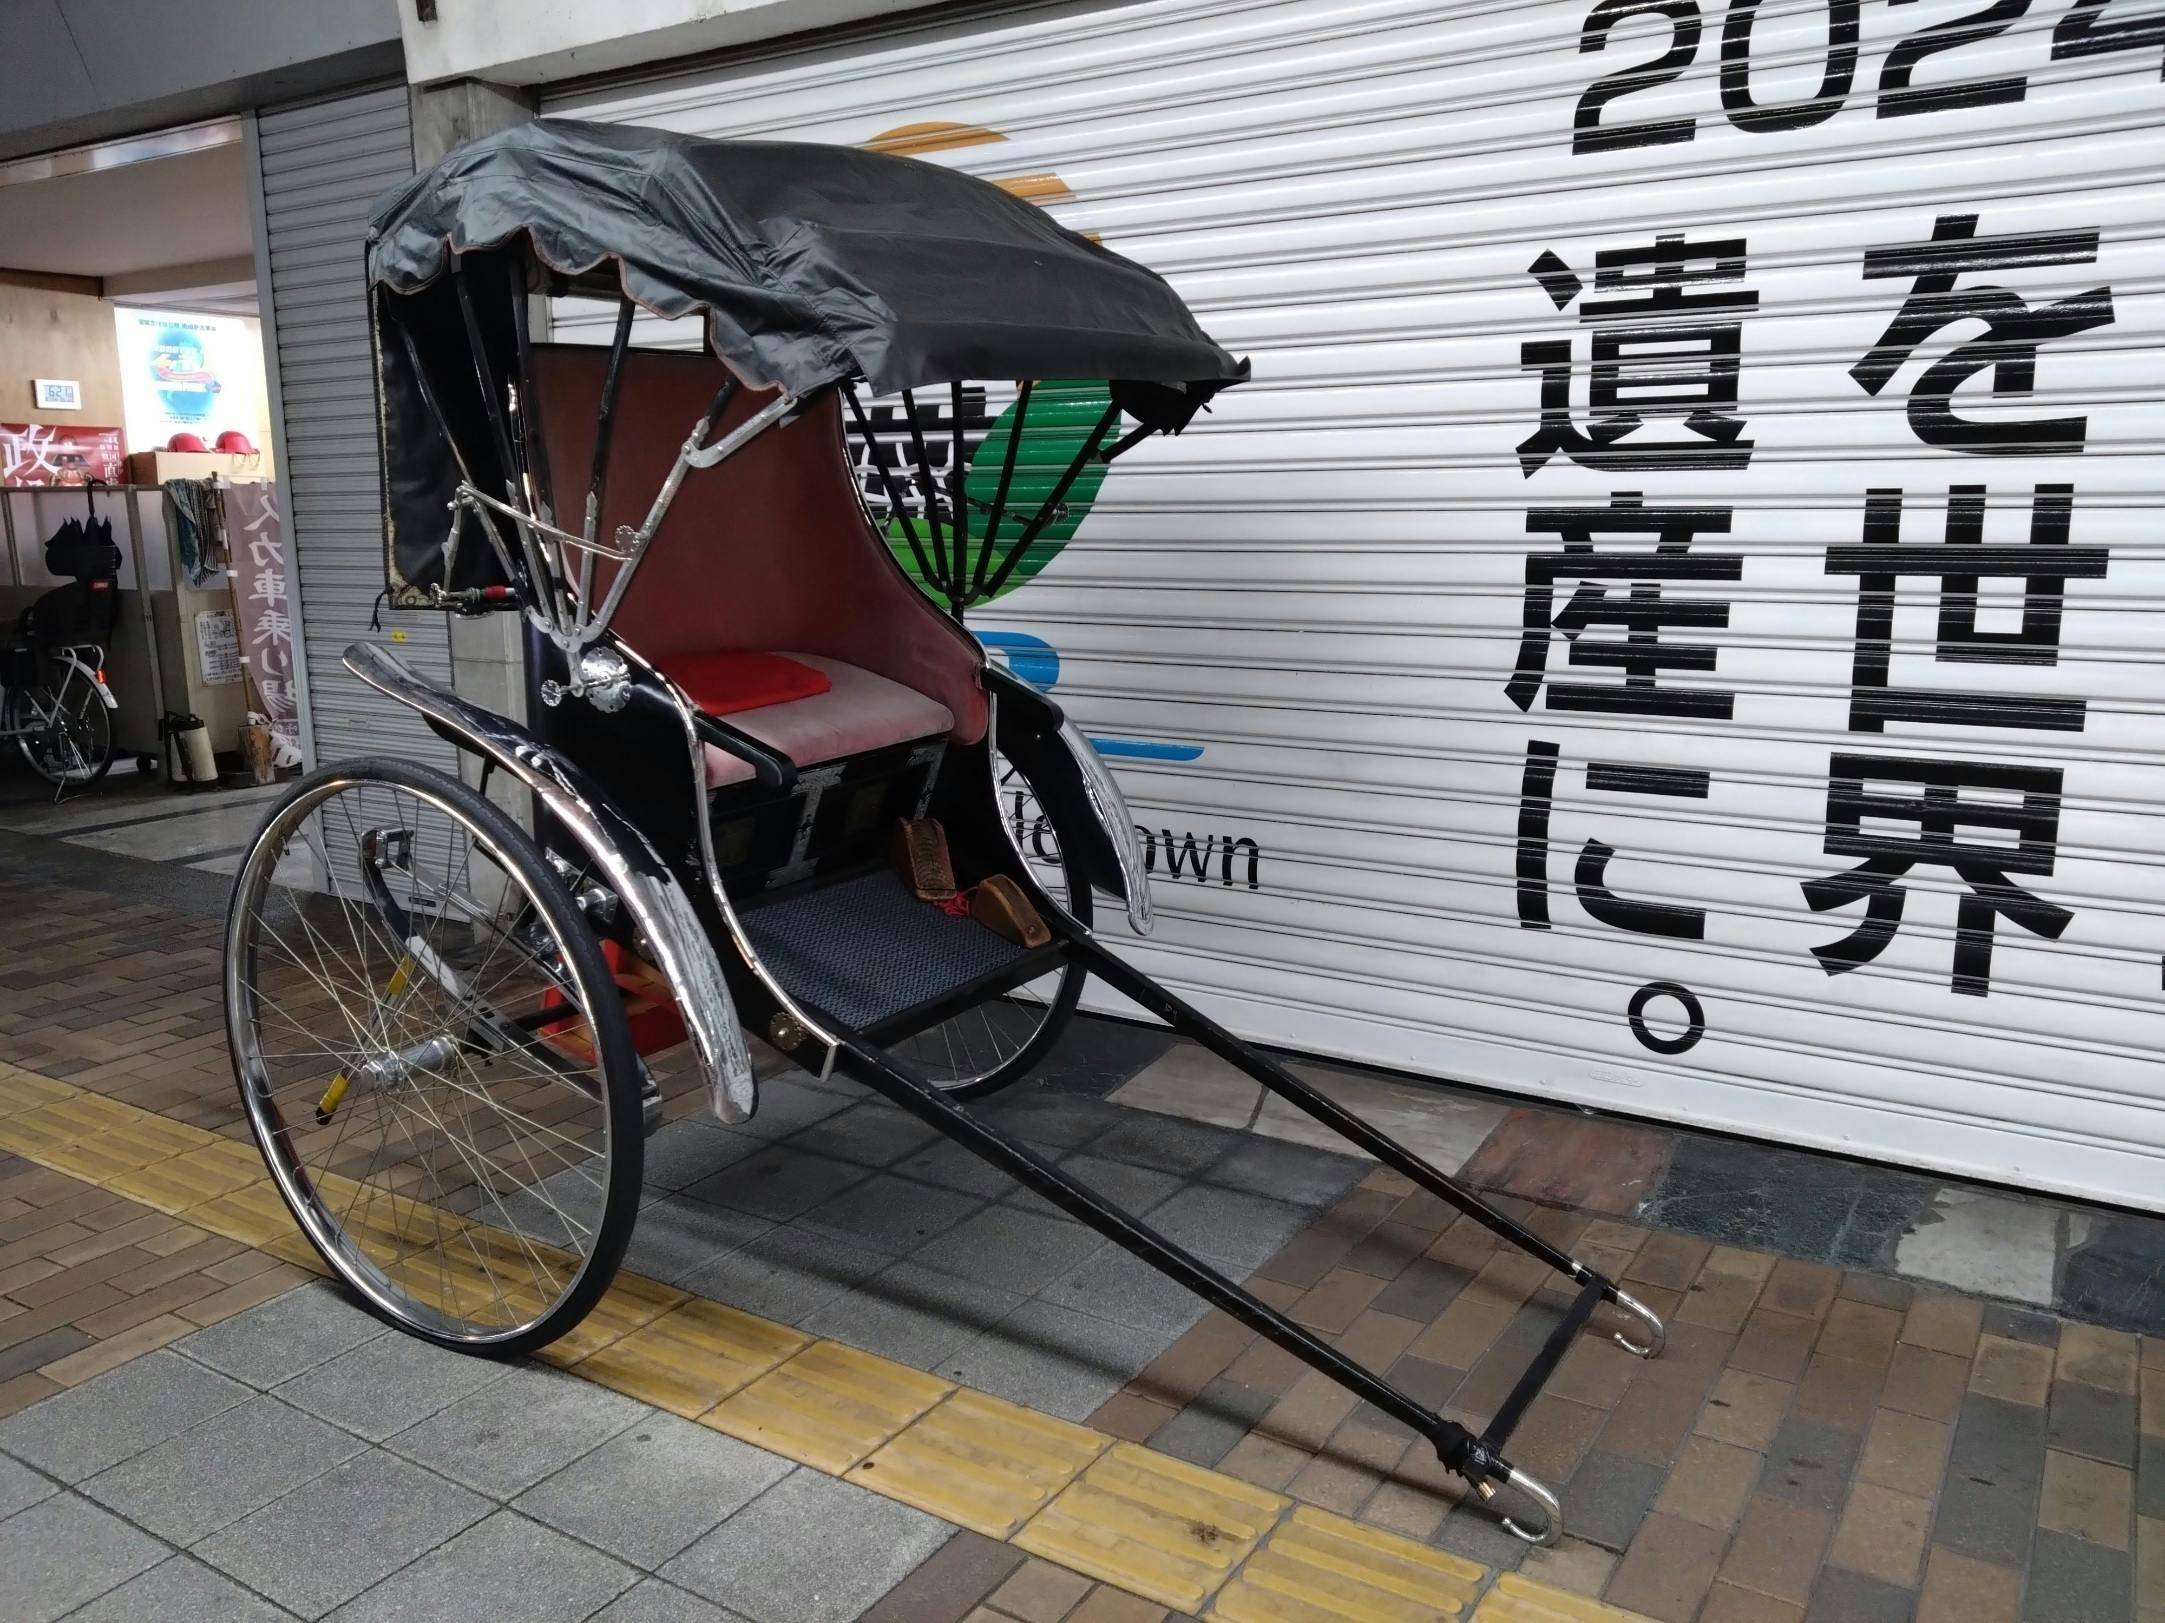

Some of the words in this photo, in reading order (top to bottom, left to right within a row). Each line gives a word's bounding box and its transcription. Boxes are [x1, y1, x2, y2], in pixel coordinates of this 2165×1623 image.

[1502, 233, 1761, 1055] 遺産に。
[1800, 213, 2117, 998] を世界
